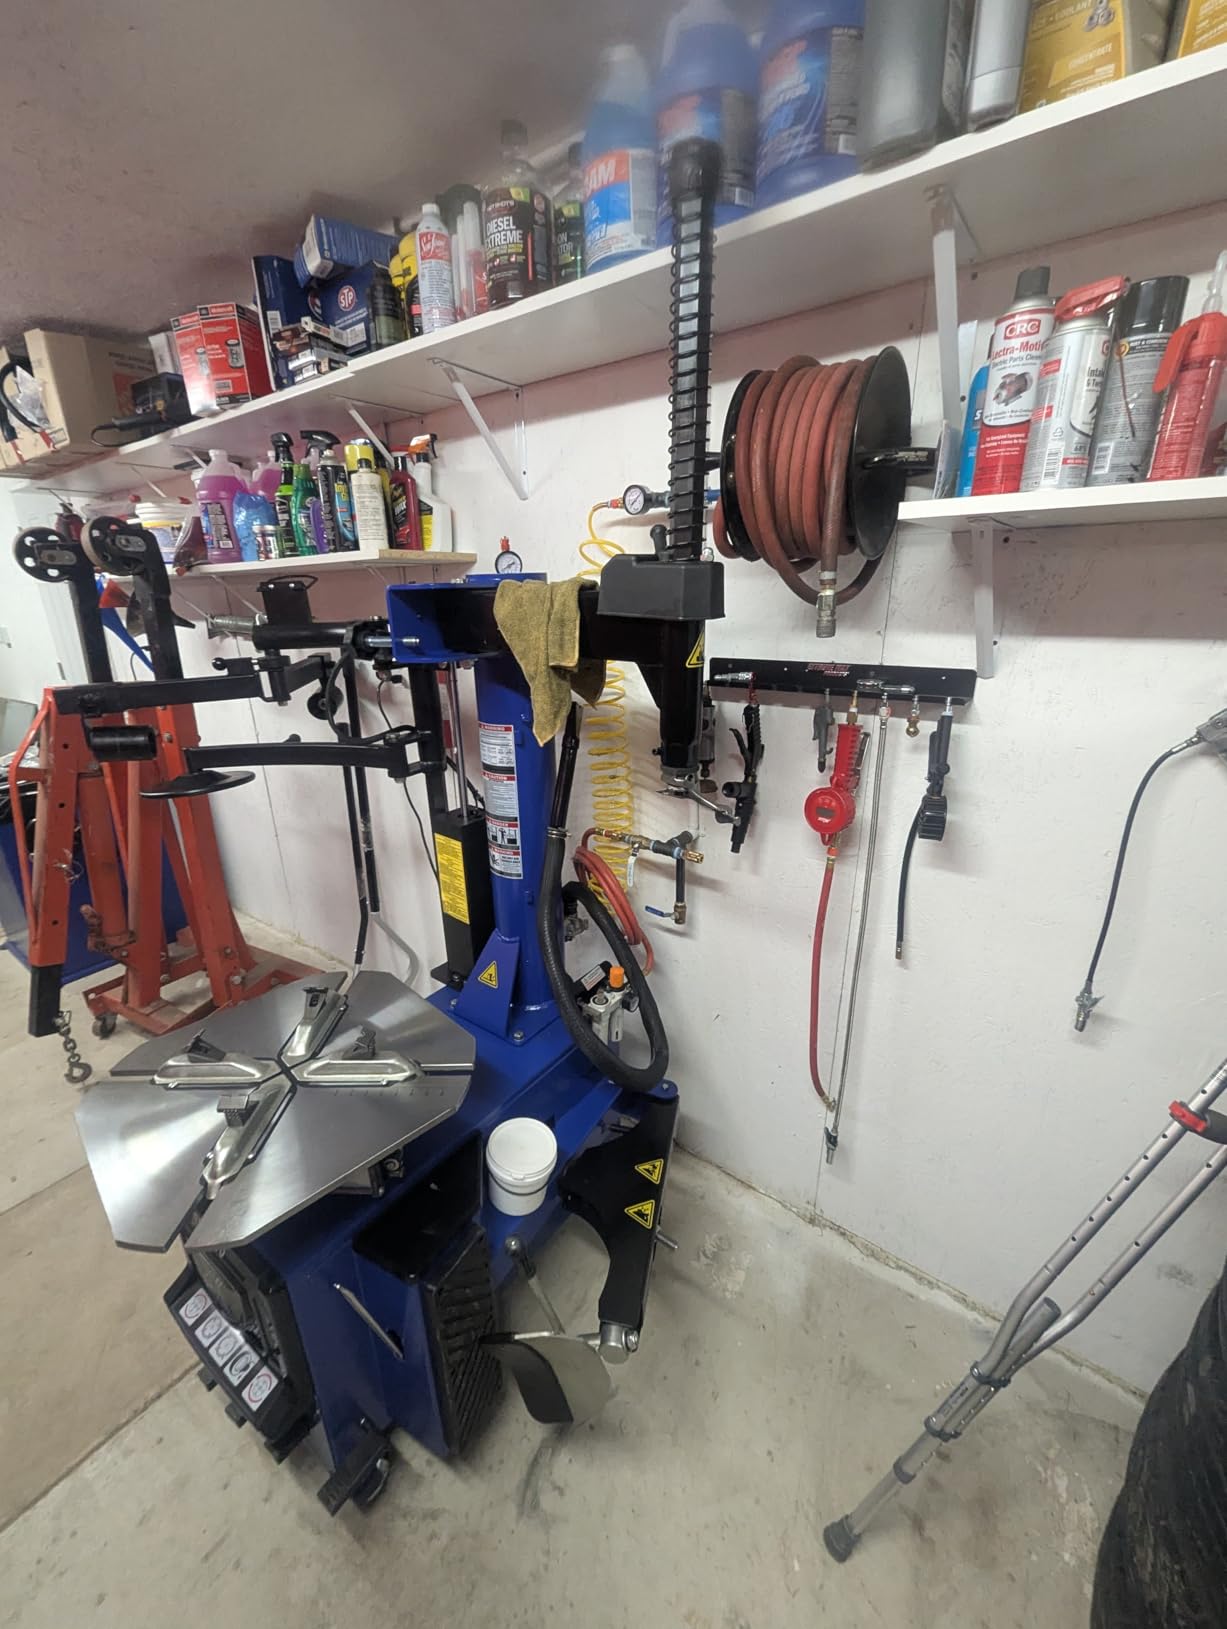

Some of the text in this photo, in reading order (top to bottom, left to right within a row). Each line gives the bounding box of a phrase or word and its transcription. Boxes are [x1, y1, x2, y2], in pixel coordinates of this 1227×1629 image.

[486, 215, 516, 236] DIESEL
[486, 230, 523, 249] EXTREME
[340, 288, 354, 309] STP
[1005, 320, 1039, 338] CRC
